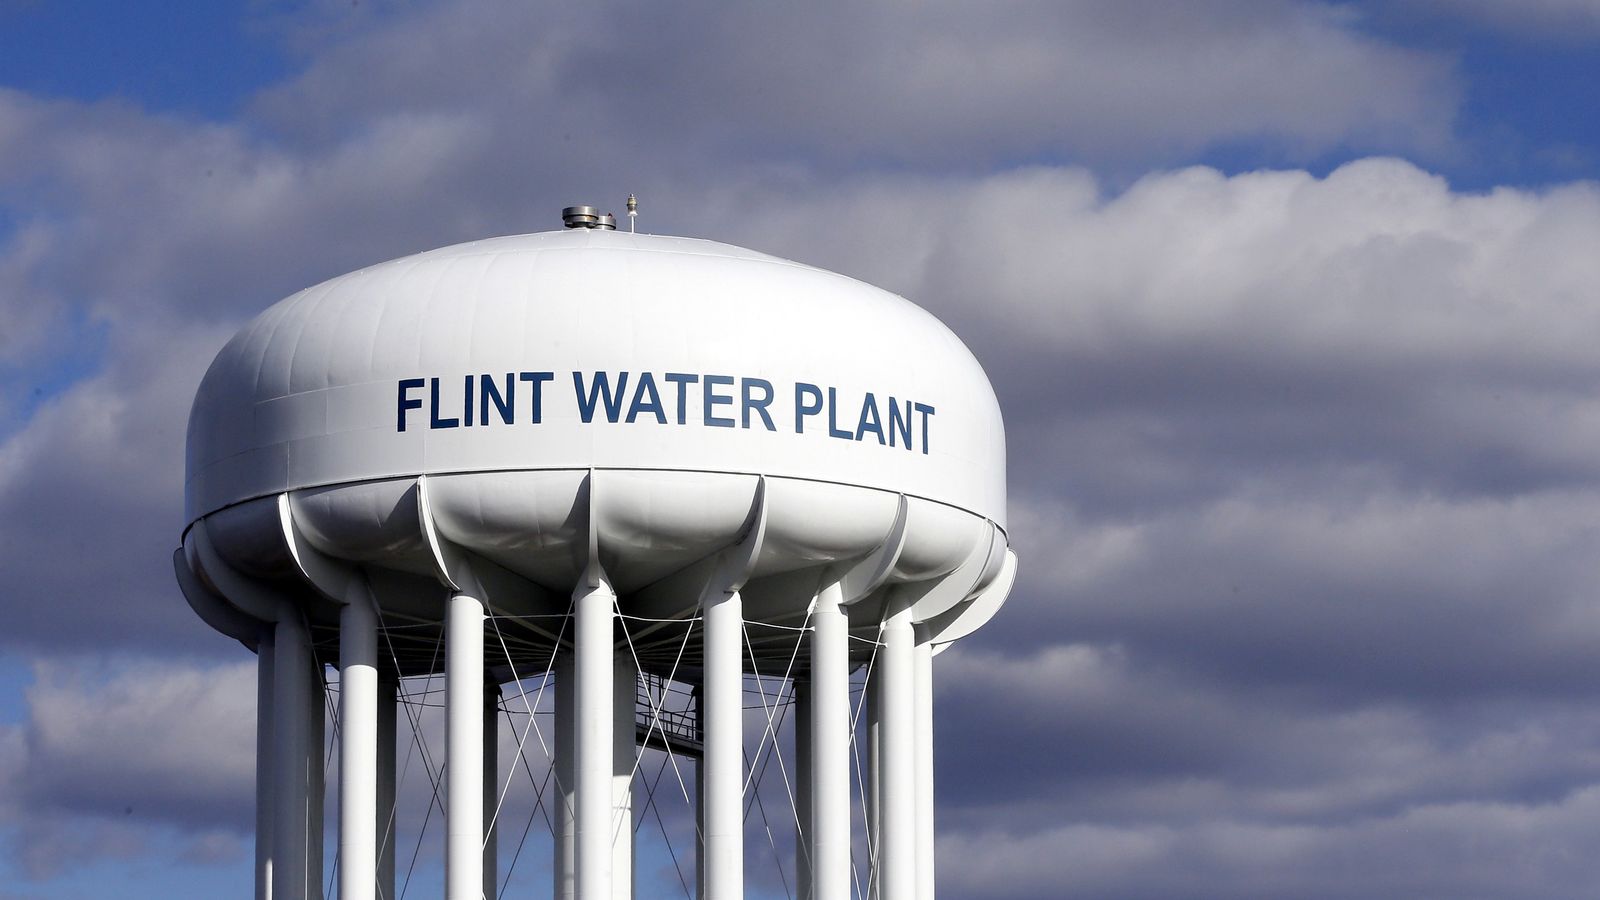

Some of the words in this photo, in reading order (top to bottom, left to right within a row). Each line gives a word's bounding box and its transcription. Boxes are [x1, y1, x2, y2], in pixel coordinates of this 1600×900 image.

[397, 371, 554, 432] FLINT
[573, 371, 777, 431] WATER
[795, 382, 935, 455] PLANT
